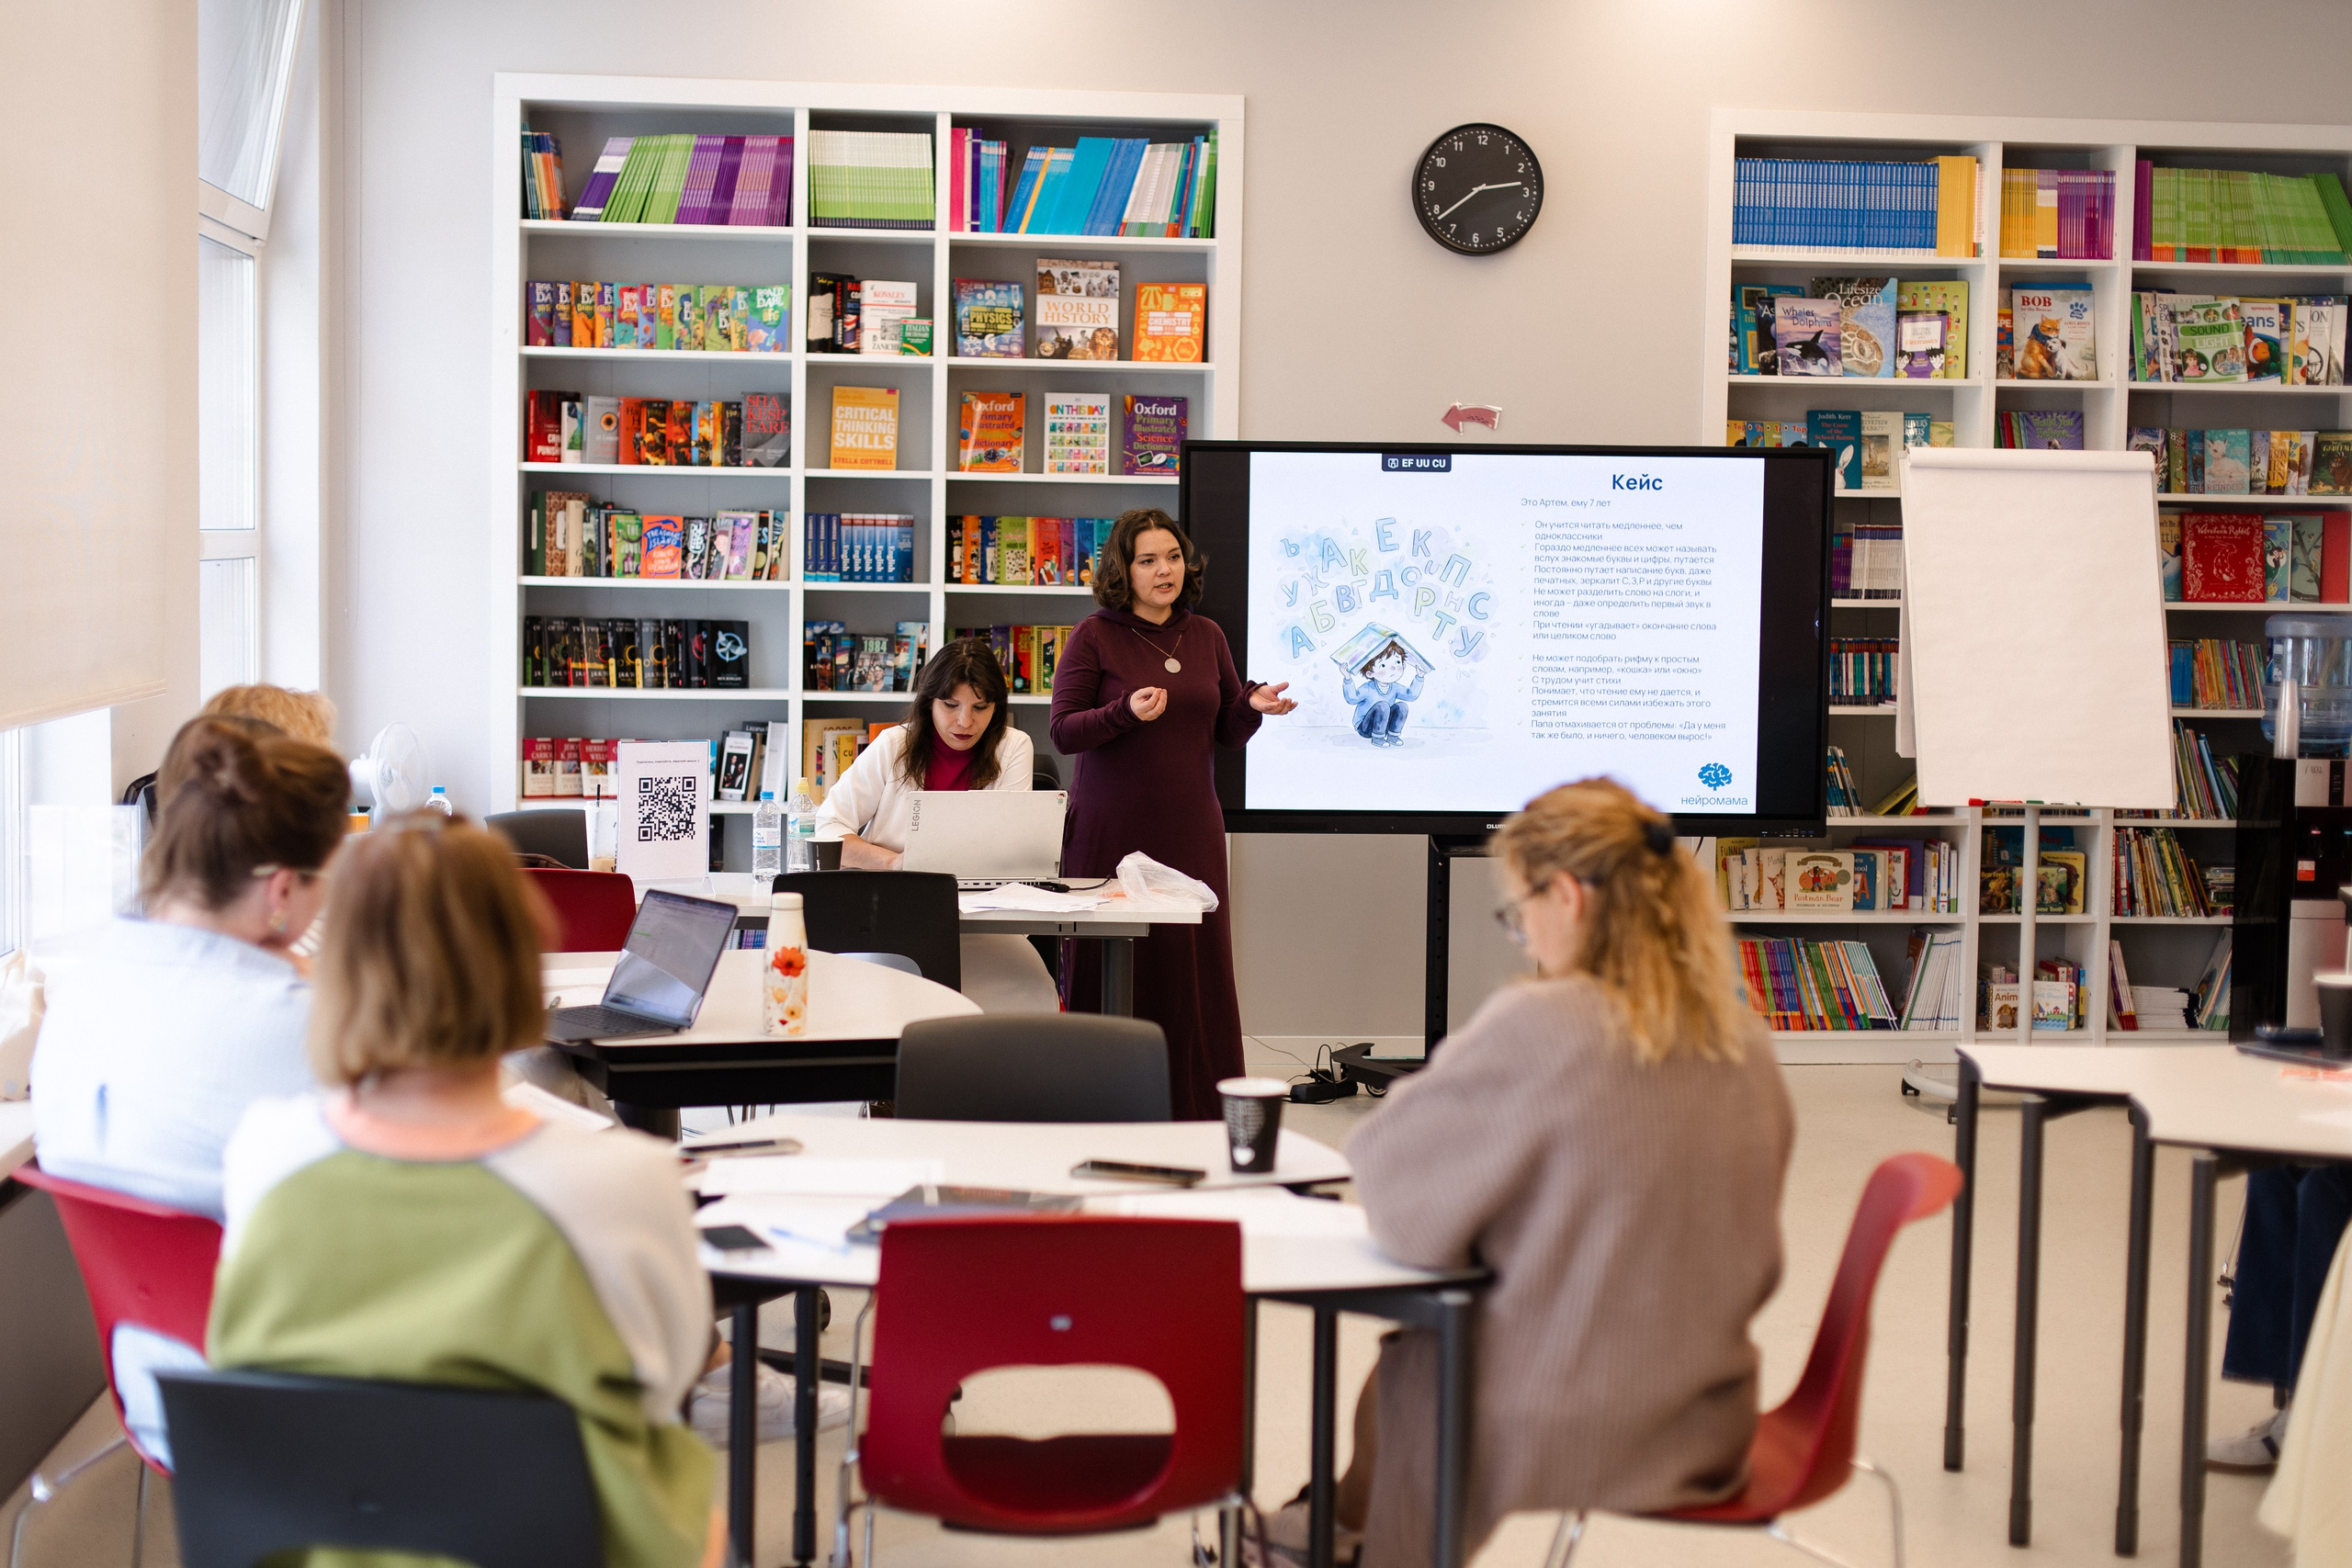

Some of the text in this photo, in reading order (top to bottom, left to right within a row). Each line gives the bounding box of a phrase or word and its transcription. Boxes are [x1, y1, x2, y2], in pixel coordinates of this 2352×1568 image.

[1477, 135, 1488, 145] 12
[1453, 141, 1463, 151] 11
[1505, 145, 1510, 154] 1
[1435, 157, 1446, 167] 10
[1518, 164, 1524, 173] 2
[1428, 181, 1435, 190] 9
[1522, 187, 1529, 197] 3
[1433, 204, 1440, 214] 8
[1516, 210, 1522, 220] 4
[1450, 224, 1456, 233] 7
[1497, 228, 1504, 237] 5
[1472, 233, 1479, 243] 6
[756, 288, 785, 298] ROALD
[1839, 284, 1882, 295] Lifesize
[756, 295, 785, 308] DAHL
[1824, 293, 1883, 309] Ocean
[2020, 296, 2052, 307] BOB
[1046, 301, 1109, 313] WORLD
[1782, 307, 1815, 317] Whales
[970, 311, 1012, 323] PHYSICS
[1044, 312, 1112, 324] HISTORY
[1148, 315, 1192, 327] CHEMISTRY
[1792, 317, 1832, 328] Dolphins
[2190, 323, 2230, 335] SOUND
[2196, 335, 2230, 348] LIGHT
[747, 395, 779, 408] SHA
[972, 400, 1014, 412] Oxford
[835, 406, 896, 422] CRITICAL
[1049, 404, 1106, 415] ON THIS DAY
[1135, 402, 1177, 415] Oxford
[747, 408, 786, 421] KESP
[1136, 415, 1175, 426] Primary
[747, 421, 790, 434] EARE
[835, 420, 896, 434] THINKING
[1134, 423, 1177, 434] Illustrated
[834, 433, 895, 449] SKILLS
[1136, 433, 1173, 442] Science
[1133, 442, 1177, 452] Dictionary
[833, 457, 858, 465] STELLA
[1402, 458, 1446, 468] EF UU CU
[1612, 473, 1663, 491] Кейс
[1521, 498, 1537, 506] Это
[1539, 498, 1568, 508] Артем,
[1571, 500, 1588, 508] ему
[1535, 520, 1547, 528] Он
[1549, 522, 1578, 530] учится
[1535, 543, 1571, 553] Гораздо
[1573, 545, 1622, 553] медленнее
[1534, 556, 1559, 564] вслух
[1606, 555, 1632, 565] буквы
[1641, 555, 1671, 565] цифры,
[1674, 558, 1713, 566] путается
[1534, 565, 1583, 573] Постоянно
[1584, 567, 1614, 575] путает
[1665, 566, 1686, 576] букв,
[1580, 578, 1620, 586] зеркалит
[1653, 579, 1684, 587] другие
[1686, 578, 1712, 588] буквы
[1534, 586, 1545, 594] Не
[1577, 589, 1623, 597] разделить
[1533, 600, 1565, 608] иногда
[1597, 601, 1649, 609] определить
[1651, 600, 1683, 610] первый
[1685, 602, 1704, 610] звук
[1533, 620, 1550, 630] При
[1585, 623, 1640, 631] «угадывает»
[864, 640, 888, 652] 1984
[1532, 653, 1544, 661] Не
[1576, 654, 1623, 664] подобрать
[1624, 654, 1653, 664] рифму
[1661, 657, 1699, 665] простым
[1568, 667, 1613, 675] например,
[1541, 677, 1573, 685] трудом
[1575, 678, 1594, 686] учит
[1532, 686, 1577, 696] Понимает,
[1629, 689, 1645, 697] ему
[1532, 699, 1578, 707] стремится
[1643, 698, 1684, 706] избежать
[1532, 719, 1553, 728] Папа
[1630, 720, 1676, 730] проблемы:
[1679, 721, 1695, 729] «Да
[1561, 731, 1584, 740] было,
[1678, 732, 1712, 742] вырос!»
[1680, 795, 1748, 807] нейромама
[911, 799, 922, 832] LEGION
[1793, 894, 1844, 903] Postman Bear
